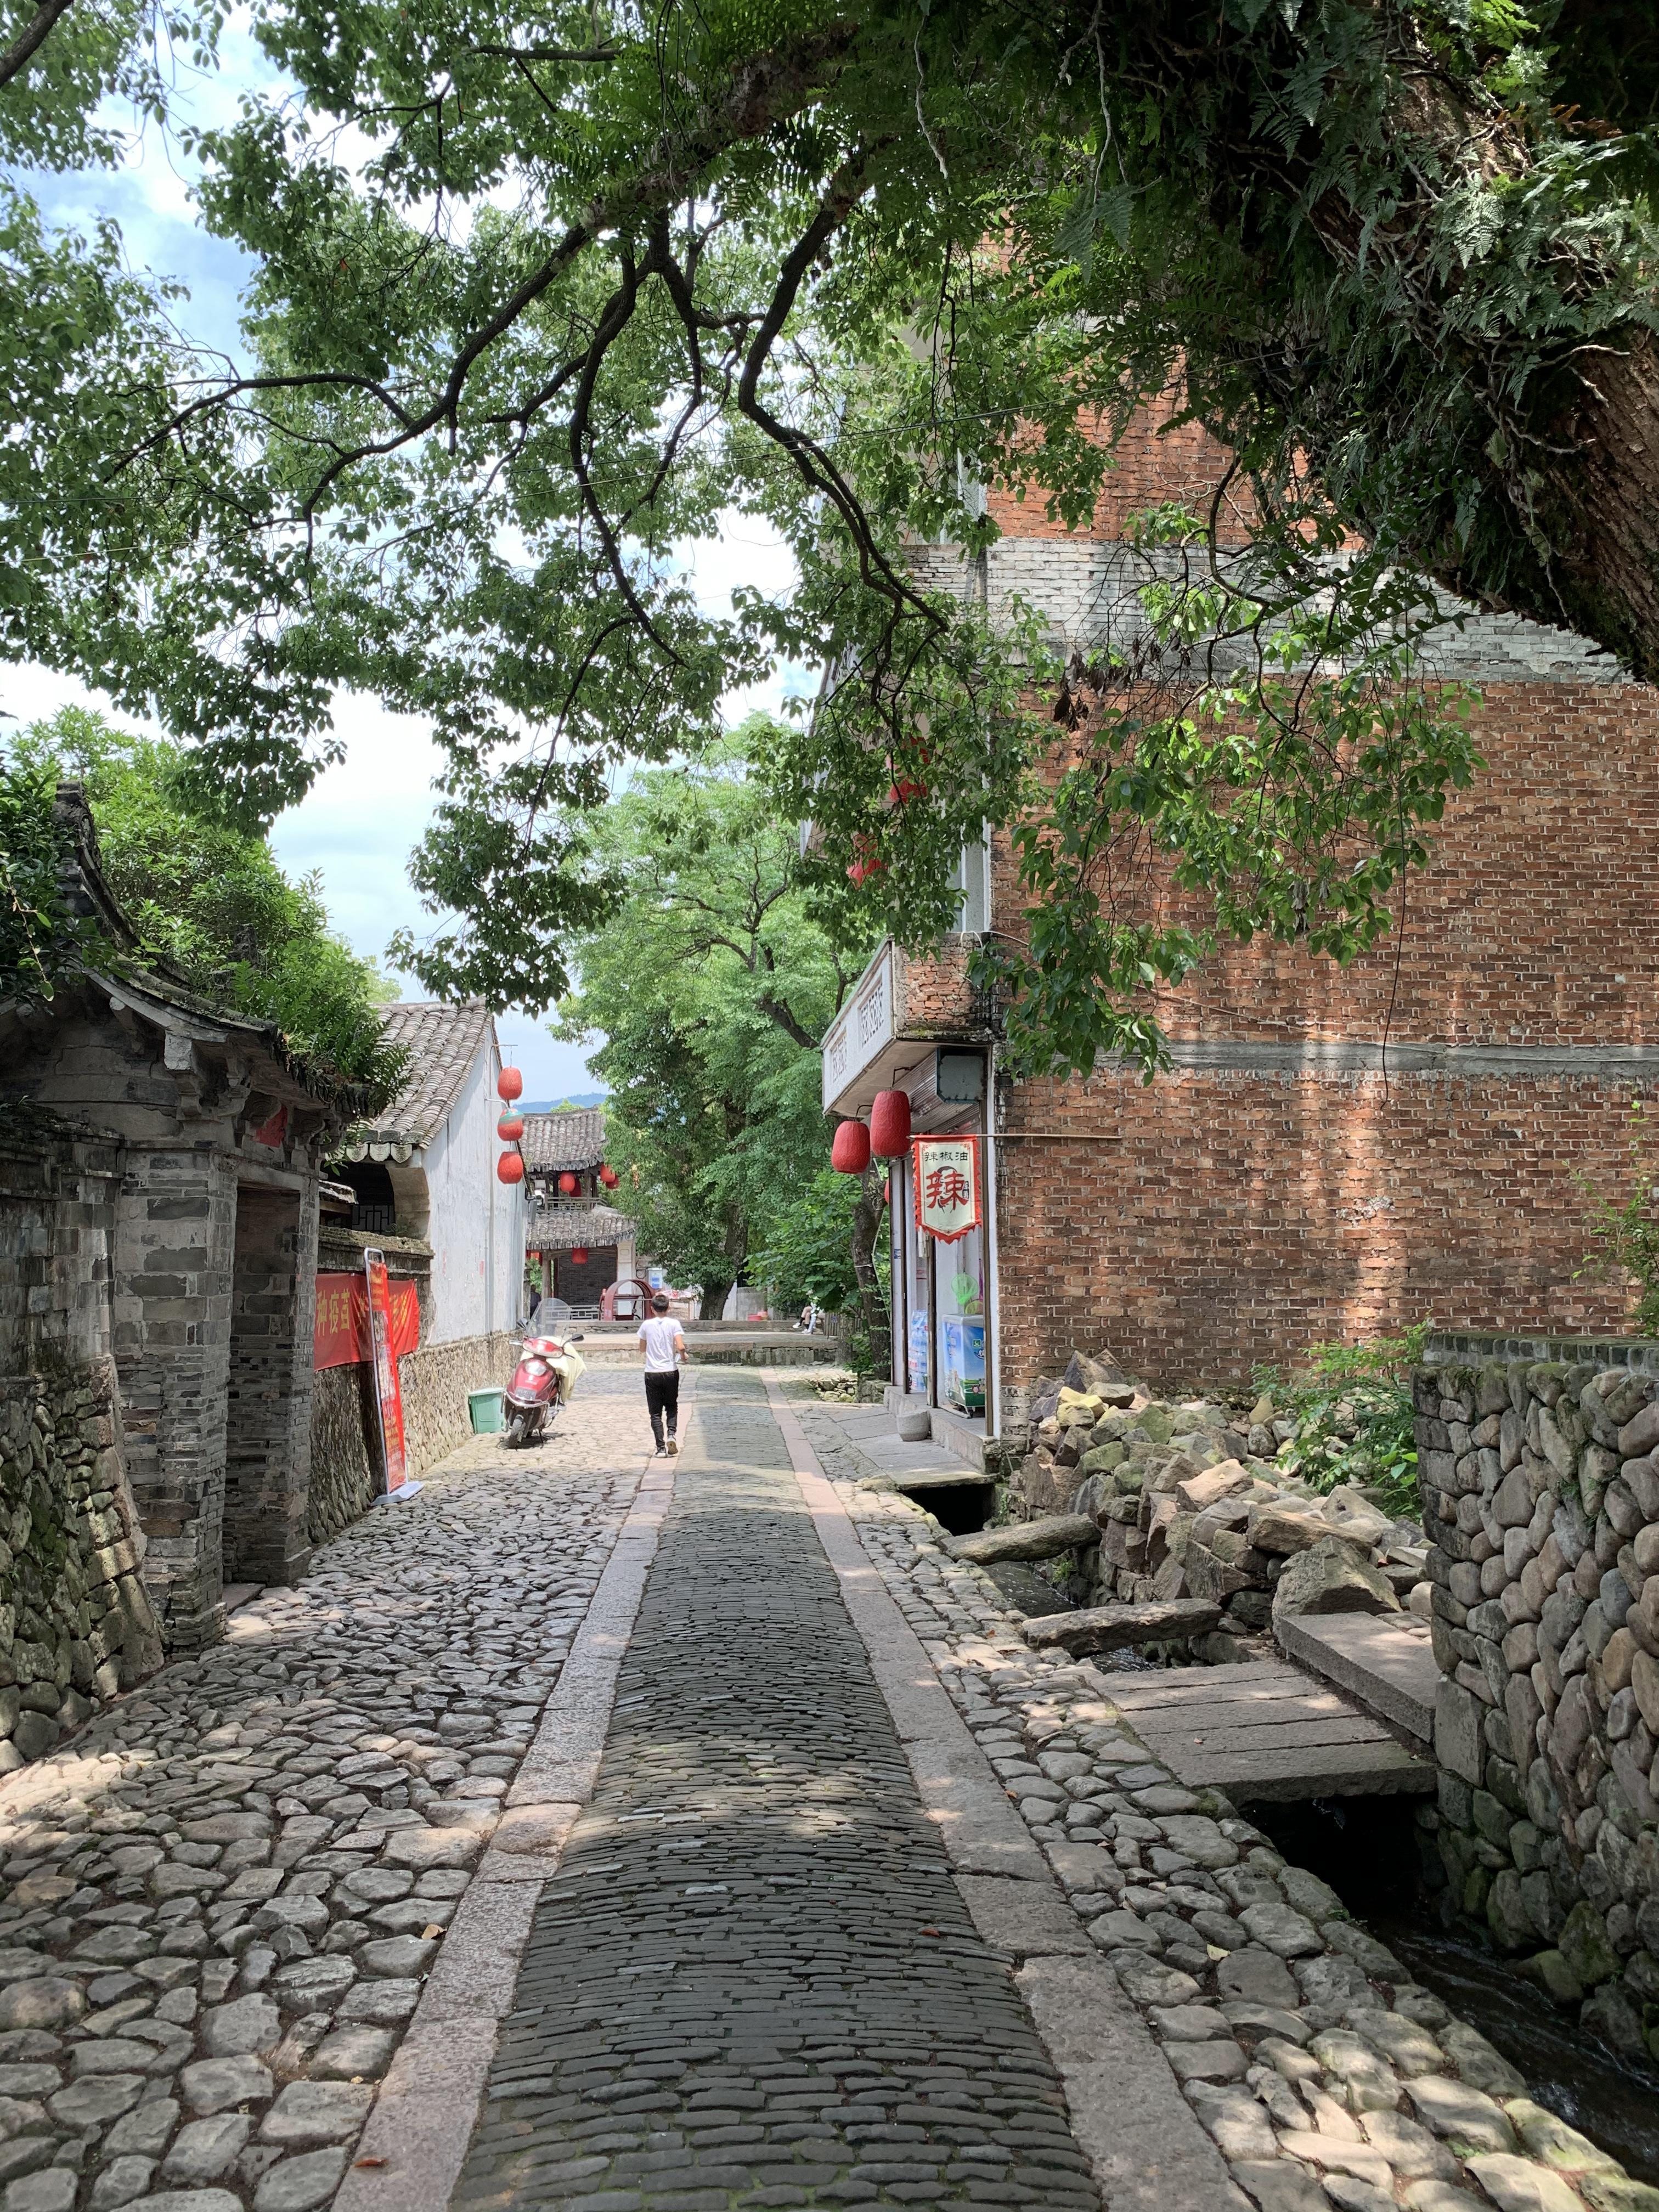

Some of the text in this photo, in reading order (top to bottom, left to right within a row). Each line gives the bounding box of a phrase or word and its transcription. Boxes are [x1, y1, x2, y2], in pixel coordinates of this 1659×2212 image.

[924, 1152, 968, 1161] 辣椒油
[926, 1170, 969, 1210] 辣
